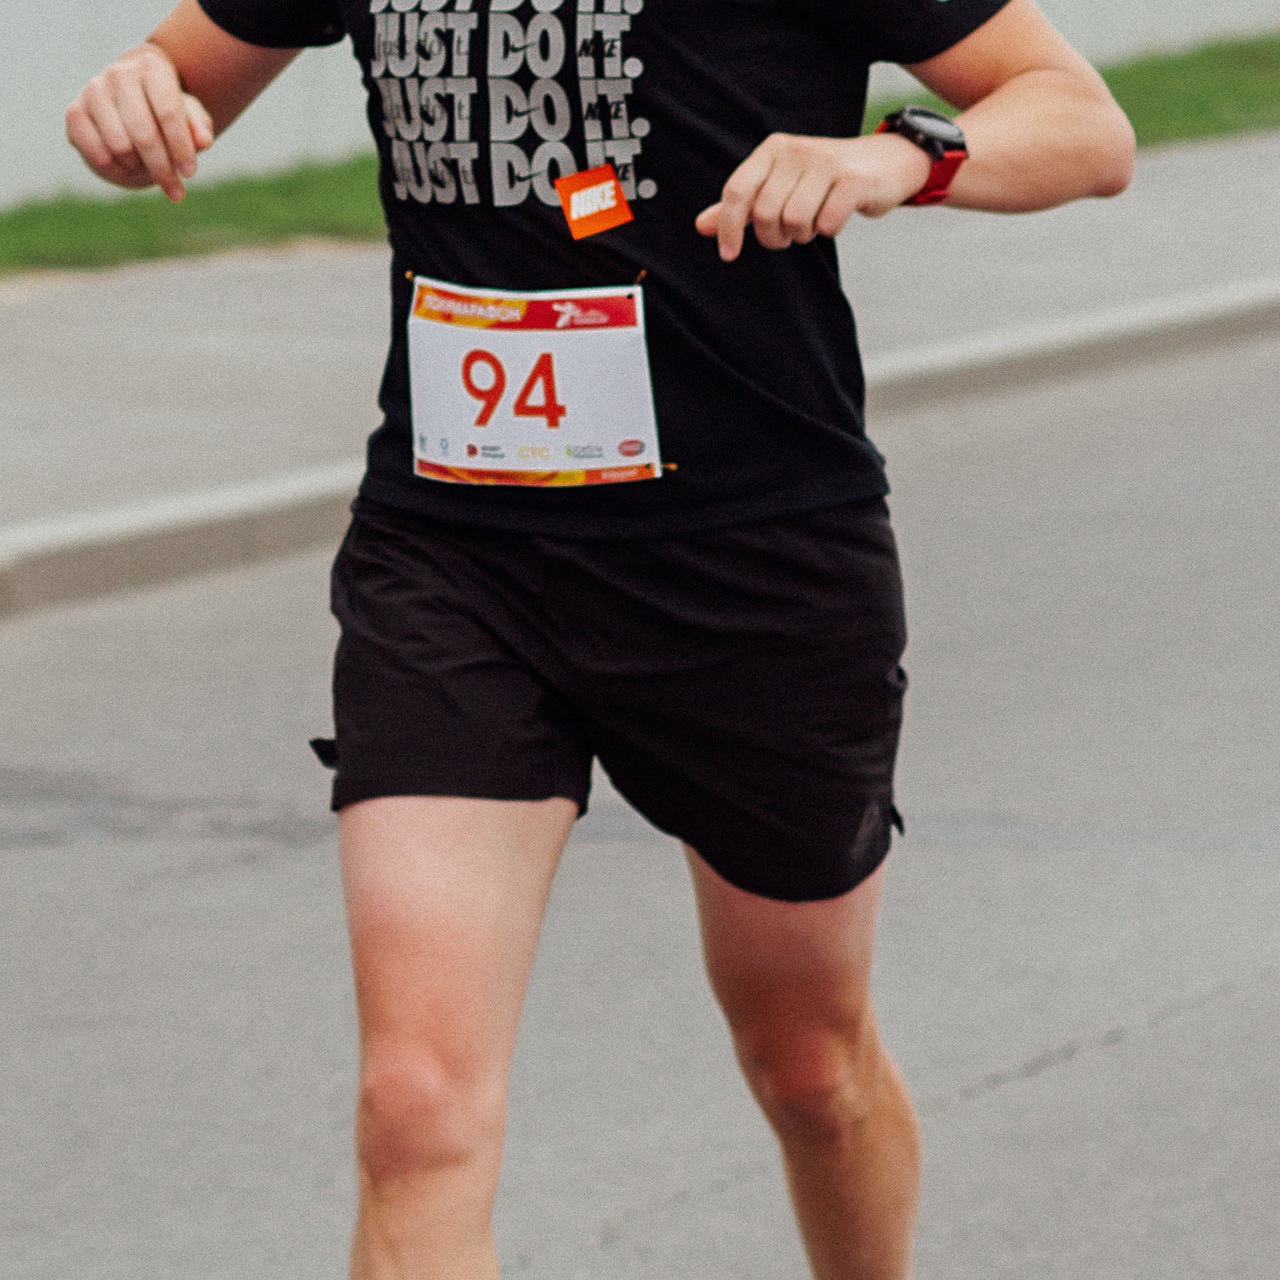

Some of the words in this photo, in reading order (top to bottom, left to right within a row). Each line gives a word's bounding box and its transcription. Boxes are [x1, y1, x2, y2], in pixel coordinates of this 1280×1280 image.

[370, 12, 478, 78] JUST
[487, 12, 567, 78] DO
[576, 13, 645, 79] IT.
[375, 78, 478, 143] JUST
[487, 78, 571, 142] DO
[578, 78, 651, 141] IT.
[391, 141, 480, 205] JUST
[489, 141, 577, 208] DO
[569, 181, 618, 221] NIKE
[462, 349, 567, 429] 94
